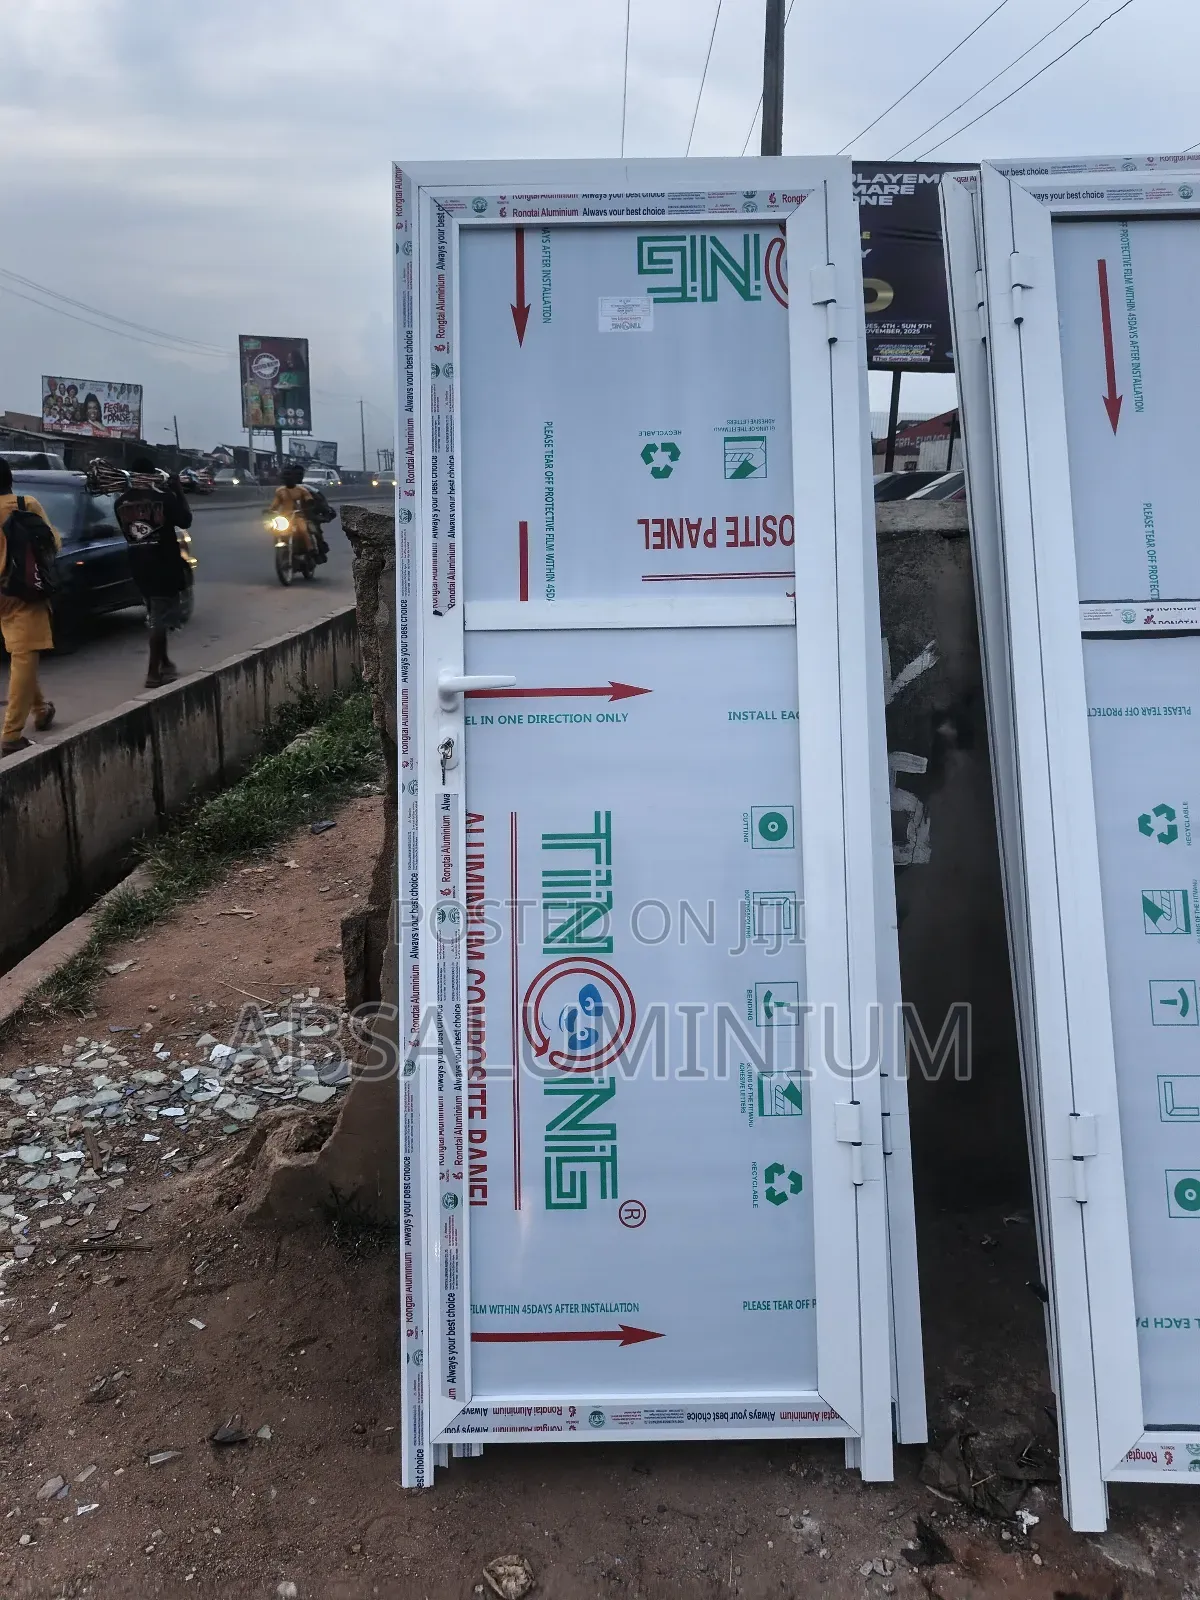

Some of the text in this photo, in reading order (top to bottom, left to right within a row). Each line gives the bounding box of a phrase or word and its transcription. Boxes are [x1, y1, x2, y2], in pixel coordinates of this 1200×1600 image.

[1011, 167, 1026, 176] best
[1026, 166, 1049, 176] choice
[1050, 192, 1065, 203] your
[1066, 191, 1081, 200] best
[1082, 189, 1104, 199] choice
[541, 207, 579, 217] Aluminium
[626, 205, 642, 216] best
[643, 205, 666, 216] choice
[435, 212, 448, 339] Rongtai Aluminium Always your best
[542, 245, 552, 324] AFTER INSTALLATION
[1119, 229, 1145, 413] PROTECTIVE FILM WITHIN 45DAYS AFTER INSTALLATION
[403, 330, 414, 352] choice
[404, 353, 414, 369] best
[404, 417, 415, 455] Aluminium
[544, 421, 554, 448] PLEASE
[544, 449, 554, 469] TEAR
[544, 470, 555, 486] OFF
[545, 486, 555, 531] PROTECTIVE
[545, 533, 555, 552] FILM
[637, 517, 717, 550] PANEL
[1142, 503, 1157, 564] PLEASE TEAR OFF
[545, 553, 556, 582] WITHIN
[481, 715, 494, 725] IN
[497, 715, 524, 725] ONE
[527, 713, 592, 724] DIRECTION
[596, 712, 629, 723] ONLY
[727, 710, 777, 721] INSTALL
[1124, 707, 1140, 717] OFF
[1140, 706, 1162, 716] TEAR
[1162, 706, 1192, 716] PLEASE
[440, 815, 451, 853] Aluminium
[441, 854, 453, 883] Rongtai
[408, 872, 419, 897] choice
[409, 934, 420, 961] Always
[409, 965, 420, 1004] Aluminium
[451, 1003, 461, 1030] choice
[453, 1095, 463, 1136] Aluminium
[751, 1160, 759, 1209] RECYCLABLE
[446, 1292, 456, 1318] choice
[489, 1303, 520, 1315] WITHIN
[521, 1303, 553, 1314] 45DAYS
[555, 1302, 579, 1313] AFTER
[581, 1301, 640, 1313] INSTALLATION
[742, 1300, 771, 1311] PLEASE
[772, 1300, 794, 1310] TEAR
[795, 1299, 810, 1310] OFF
[446, 1318, 456, 1336] best
[1154, 1318, 1191, 1329] EACH
[446, 1338, 458, 1355] your
[446, 1356, 458, 1384] Always
[686, 1411, 711, 1421] choice
[712, 1411, 730, 1422] best
[731, 1409, 748, 1421] your
[749, 1409, 776, 1421] Always
[779, 1411, 820, 1422] Aluminium
[414, 1448, 425, 1475] choice
